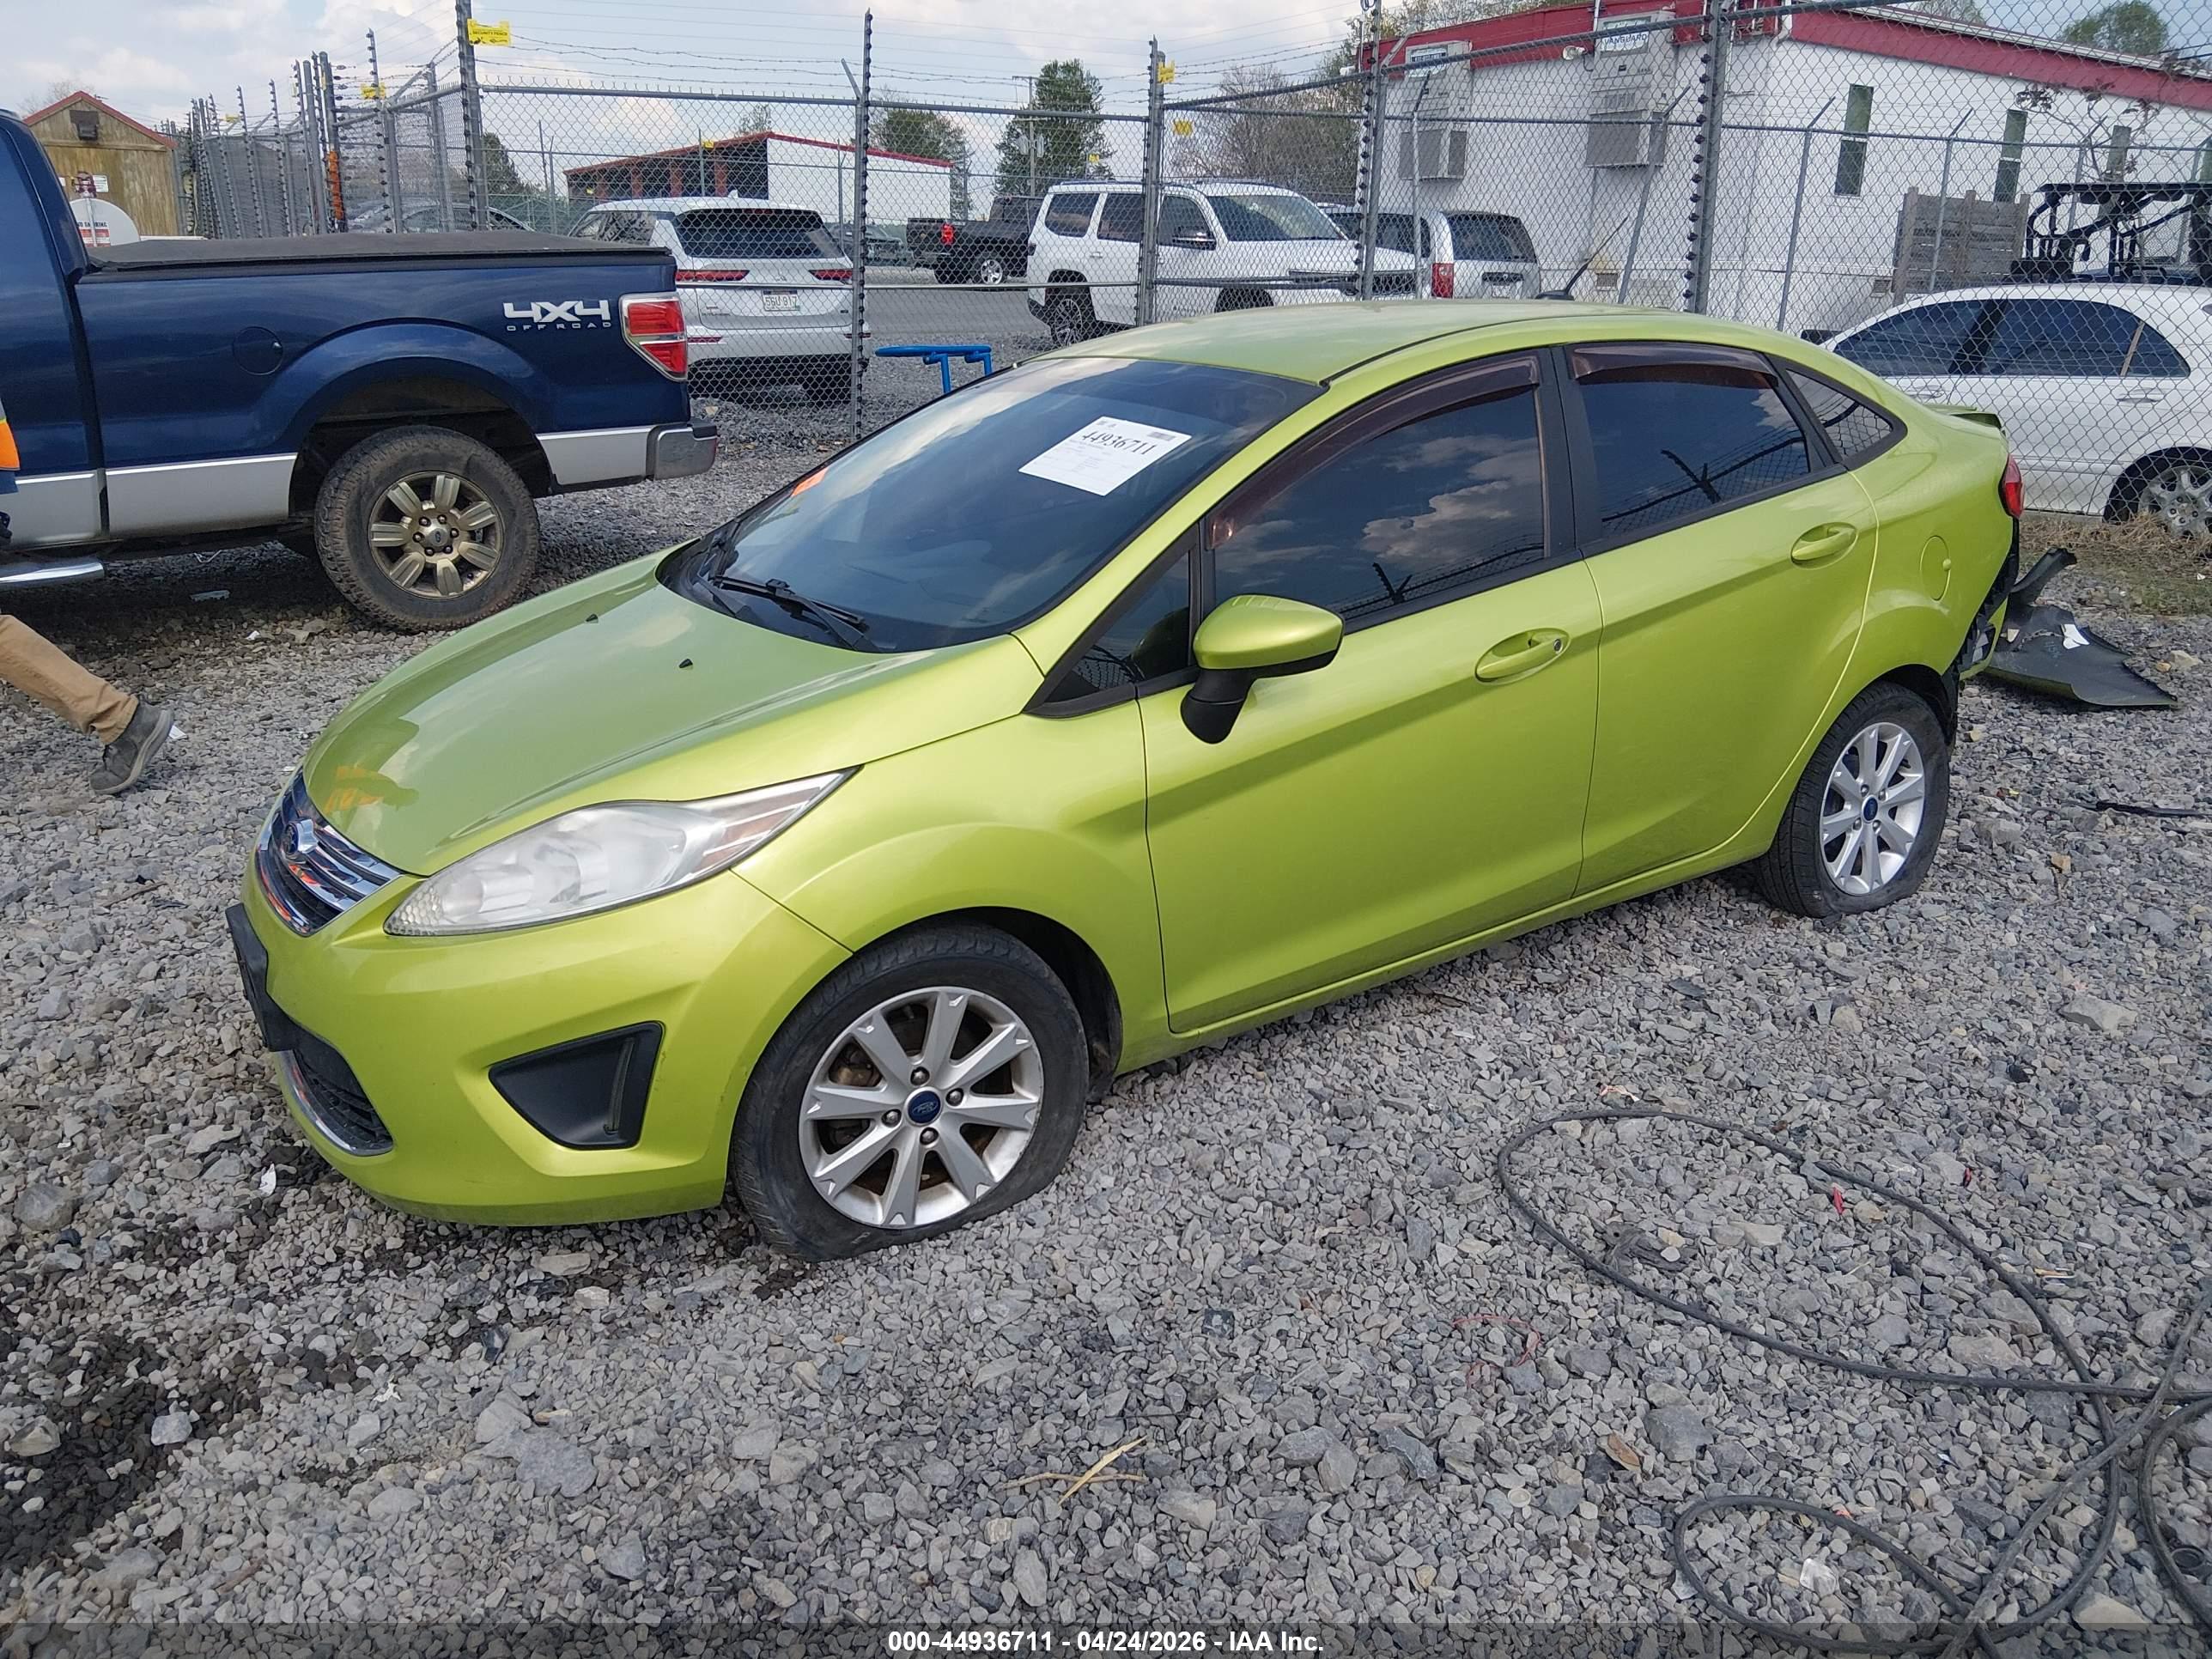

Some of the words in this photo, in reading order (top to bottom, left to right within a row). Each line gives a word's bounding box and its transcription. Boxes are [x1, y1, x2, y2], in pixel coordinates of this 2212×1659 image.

[1603, 33, 1648, 45] VANGUARD
[556, 322, 611, 331] ROAD
[1082, 430, 1158, 455] 44936711
